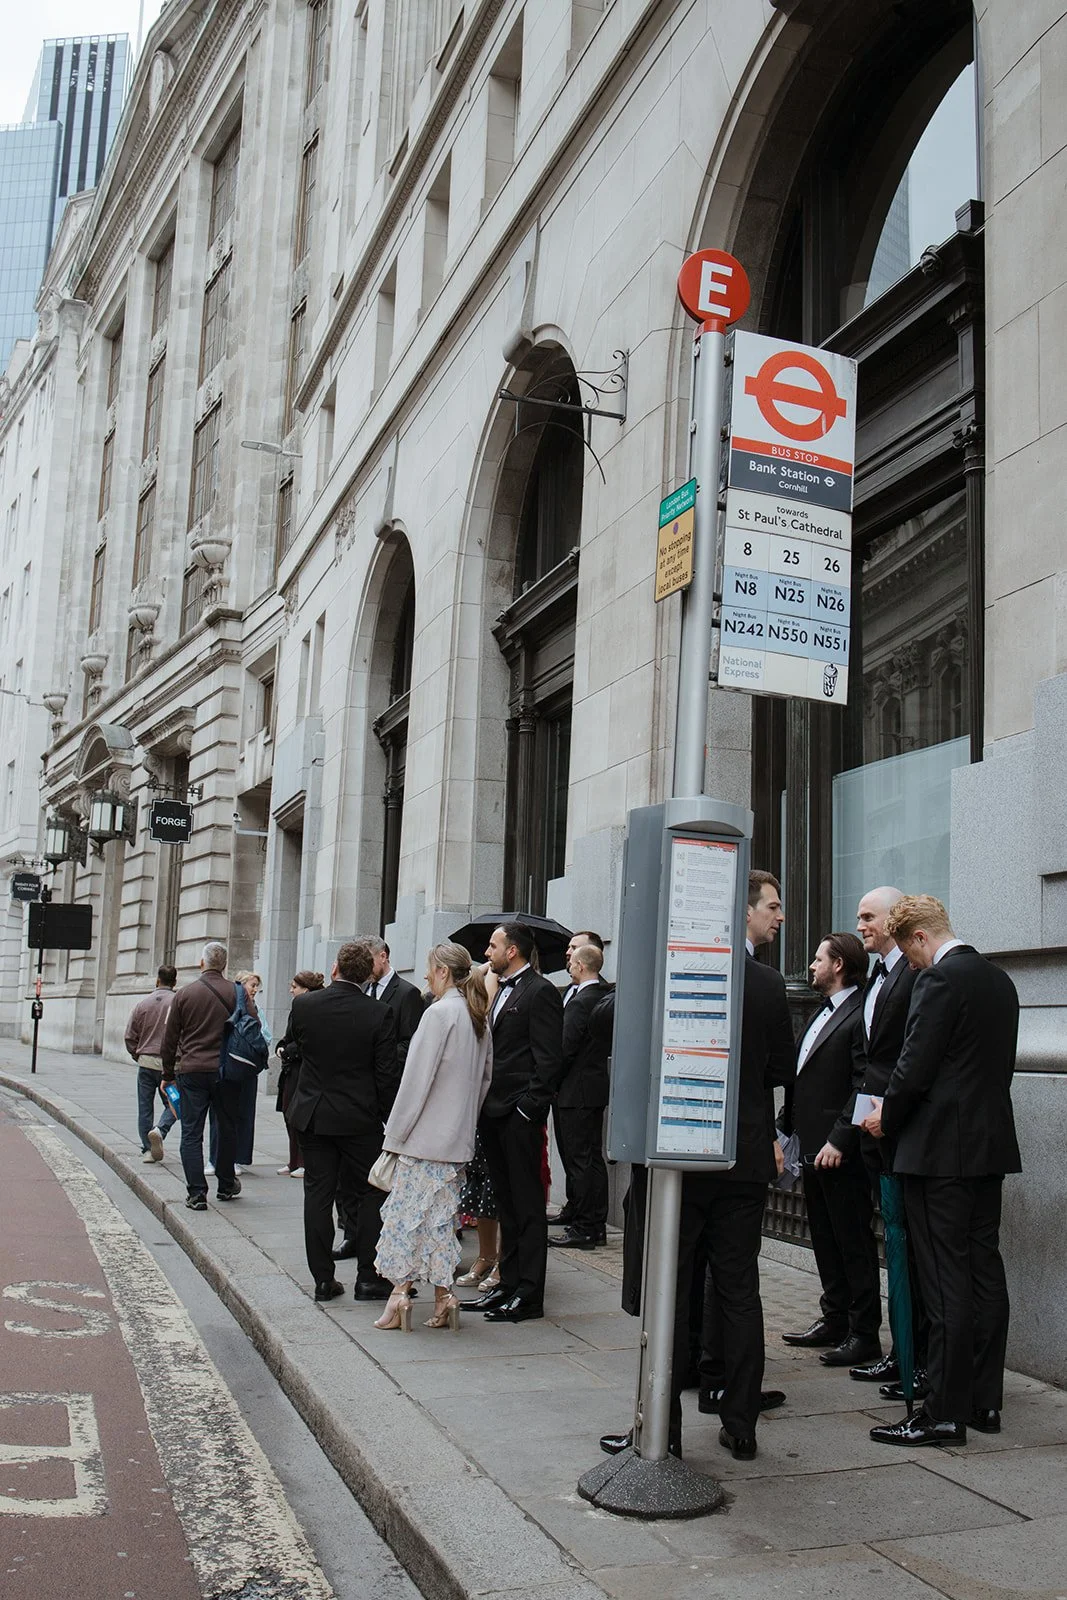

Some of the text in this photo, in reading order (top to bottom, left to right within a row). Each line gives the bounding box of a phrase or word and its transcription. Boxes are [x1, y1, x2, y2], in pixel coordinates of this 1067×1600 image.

[698, 260, 733, 318] E
[771, 446, 819, 464] BUS STOP
[749, 460, 820, 485] Bank Station
[778, 480, 808, 494] Cornhill
[666, 488, 689, 510] London Bus
[661, 495, 694, 522] Priority Network
[776, 506, 809, 520] towards
[738, 509, 843, 540] St Paul's Cathedral
[659, 531, 692, 557] No stopping
[743, 542, 752, 556] 8
[659, 545, 690, 570] at any time
[783, 550, 800, 565] 25
[824, 557, 840, 573] 26
[664, 561, 683, 578] except
[735, 571, 750, 580] Night
[658, 570, 688, 594] local buses
[735, 580, 757, 596] N8
[779, 578, 793, 587] Night
[775, 586, 805, 604] N25
[821, 587, 833, 595] Night
[817, 594, 845, 613] N26
[733, 611, 747, 620] Night
[777, 618, 791, 626] Night
[724, 619, 764, 637] N242
[768, 625, 808, 644] N550
[820, 626, 832, 634] Night
[814, 633, 847, 652] N551
[722, 656, 762, 670] National
[724, 667, 760, 680] Express
[155, 816, 187, 828] FORGE
[665, 1053, 675, 1061] 26
